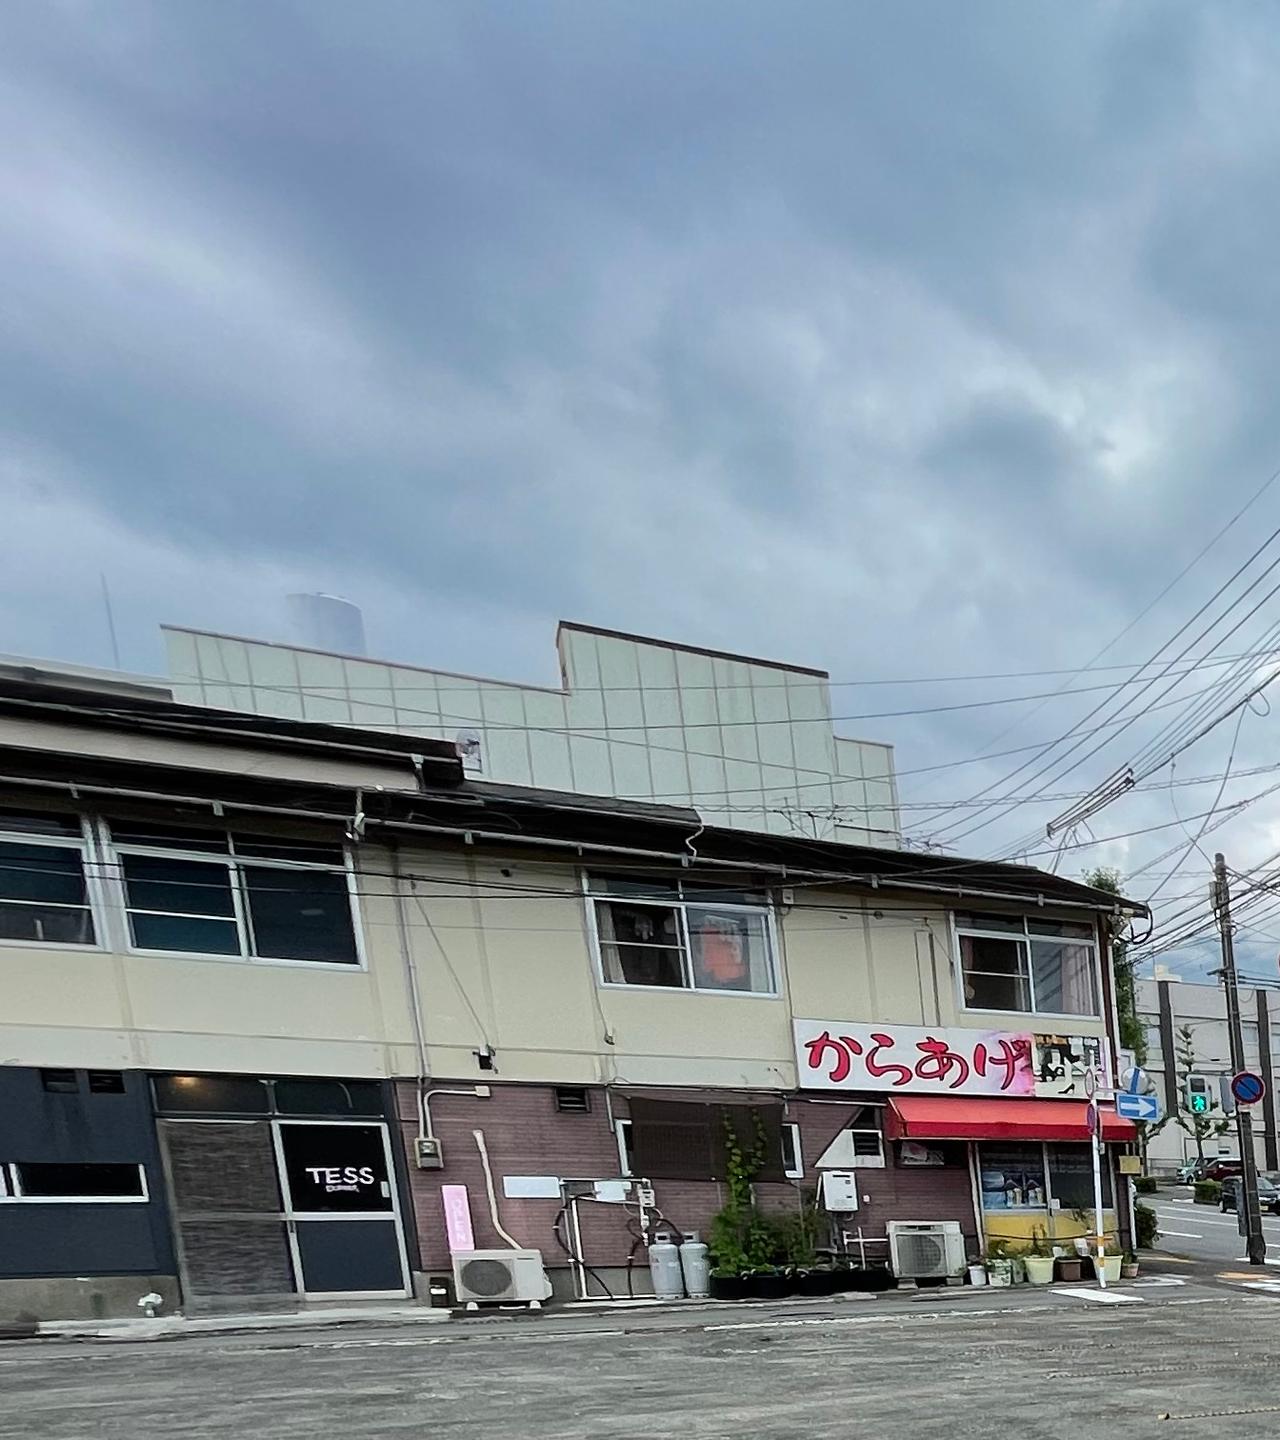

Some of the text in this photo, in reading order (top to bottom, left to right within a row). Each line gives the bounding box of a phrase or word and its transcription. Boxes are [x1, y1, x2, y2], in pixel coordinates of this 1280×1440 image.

[804, 1030, 1032, 1090] からあげ
[305, 1167, 374, 1184] TESS
